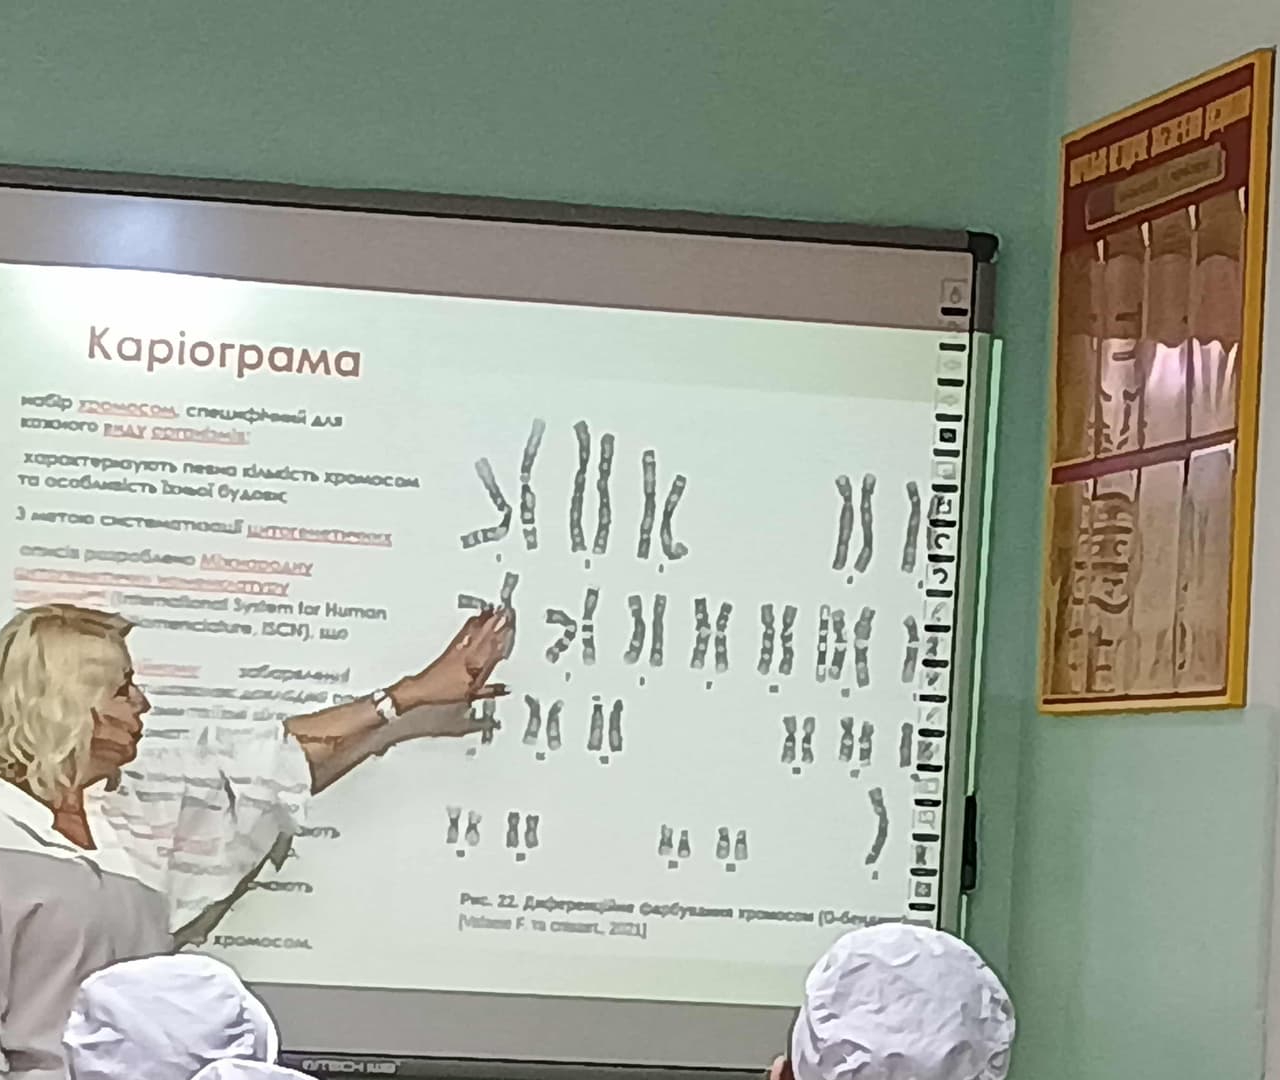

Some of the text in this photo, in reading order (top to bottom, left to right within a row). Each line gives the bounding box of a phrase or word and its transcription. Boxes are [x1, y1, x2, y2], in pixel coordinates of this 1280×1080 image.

[88, 325, 362, 378] Каріограма
[21, 418, 98, 432] кожного
[311, 415, 343, 427] для
[18, 475, 39, 487] та
[234, 597, 294, 616] System
[298, 601, 321, 617] for
[325, 602, 387, 620] Human
